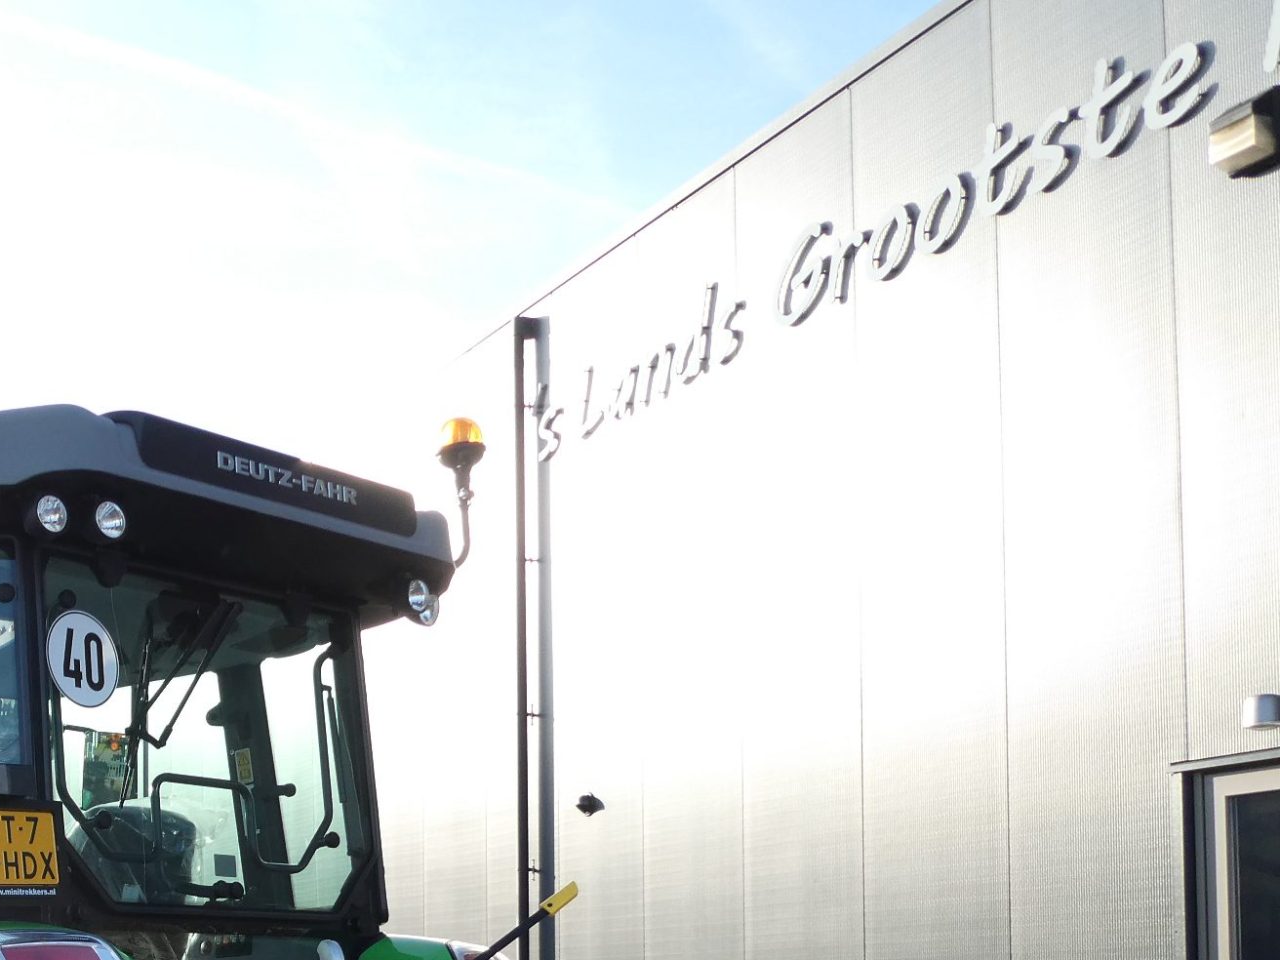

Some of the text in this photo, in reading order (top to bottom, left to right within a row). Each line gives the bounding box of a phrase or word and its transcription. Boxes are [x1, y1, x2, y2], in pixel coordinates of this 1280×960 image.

[582, 281, 747, 440] Lands
[776, 40, 1212, 328] Grootste
[217, 450, 358, 506] DEUTZ-FAHR
[63, 627, 105, 692] 40
